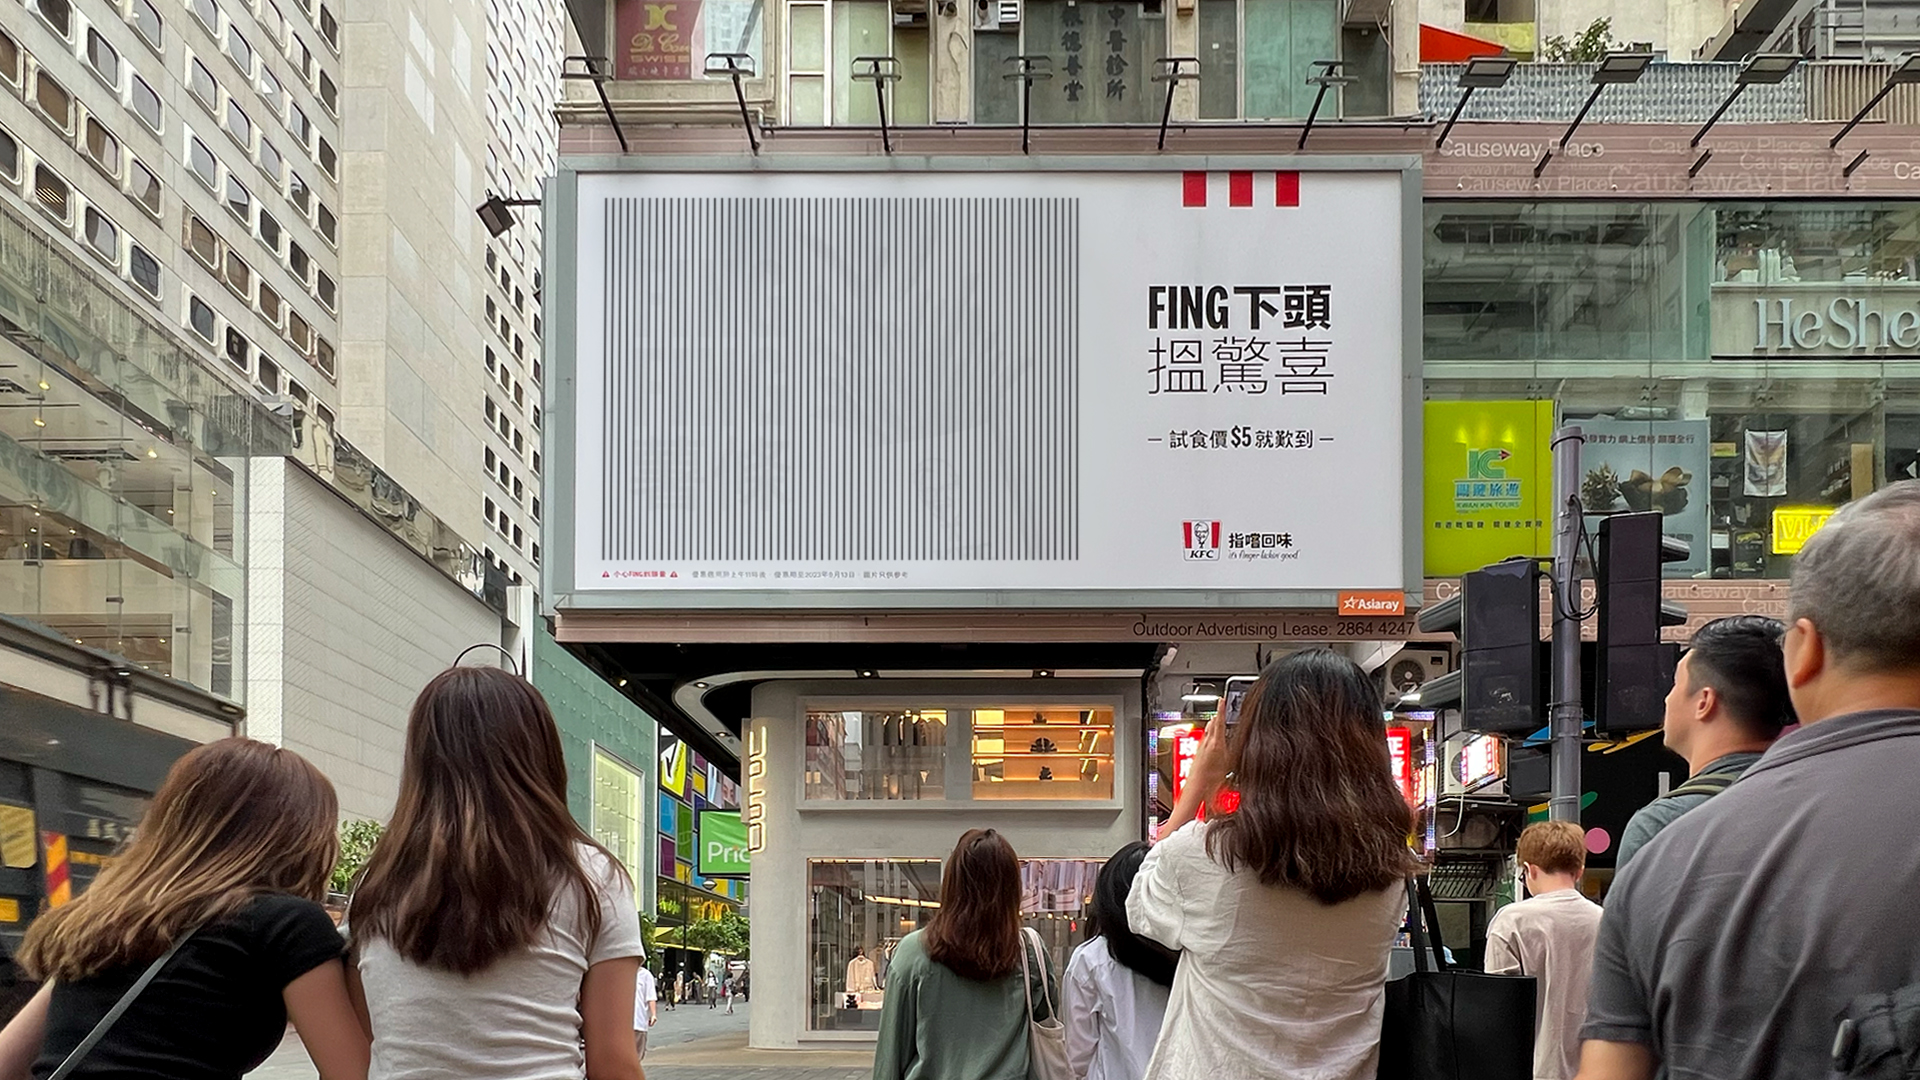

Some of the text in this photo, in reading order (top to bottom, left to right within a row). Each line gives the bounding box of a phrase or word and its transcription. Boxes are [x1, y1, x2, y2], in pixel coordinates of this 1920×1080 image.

[1439, 139, 1542, 161] Causeway
[1558, 176, 1608, 192] Place
[1148, 284, 1332, 330] FING下頭
[1189, 549, 1214, 559] KFC
[1662, 586, 1753, 602] auseway
[1357, 598, 1400, 612] Asiaray
[1133, 621, 1415, 639] Outdoor Advertising Lease: 2864 4247
